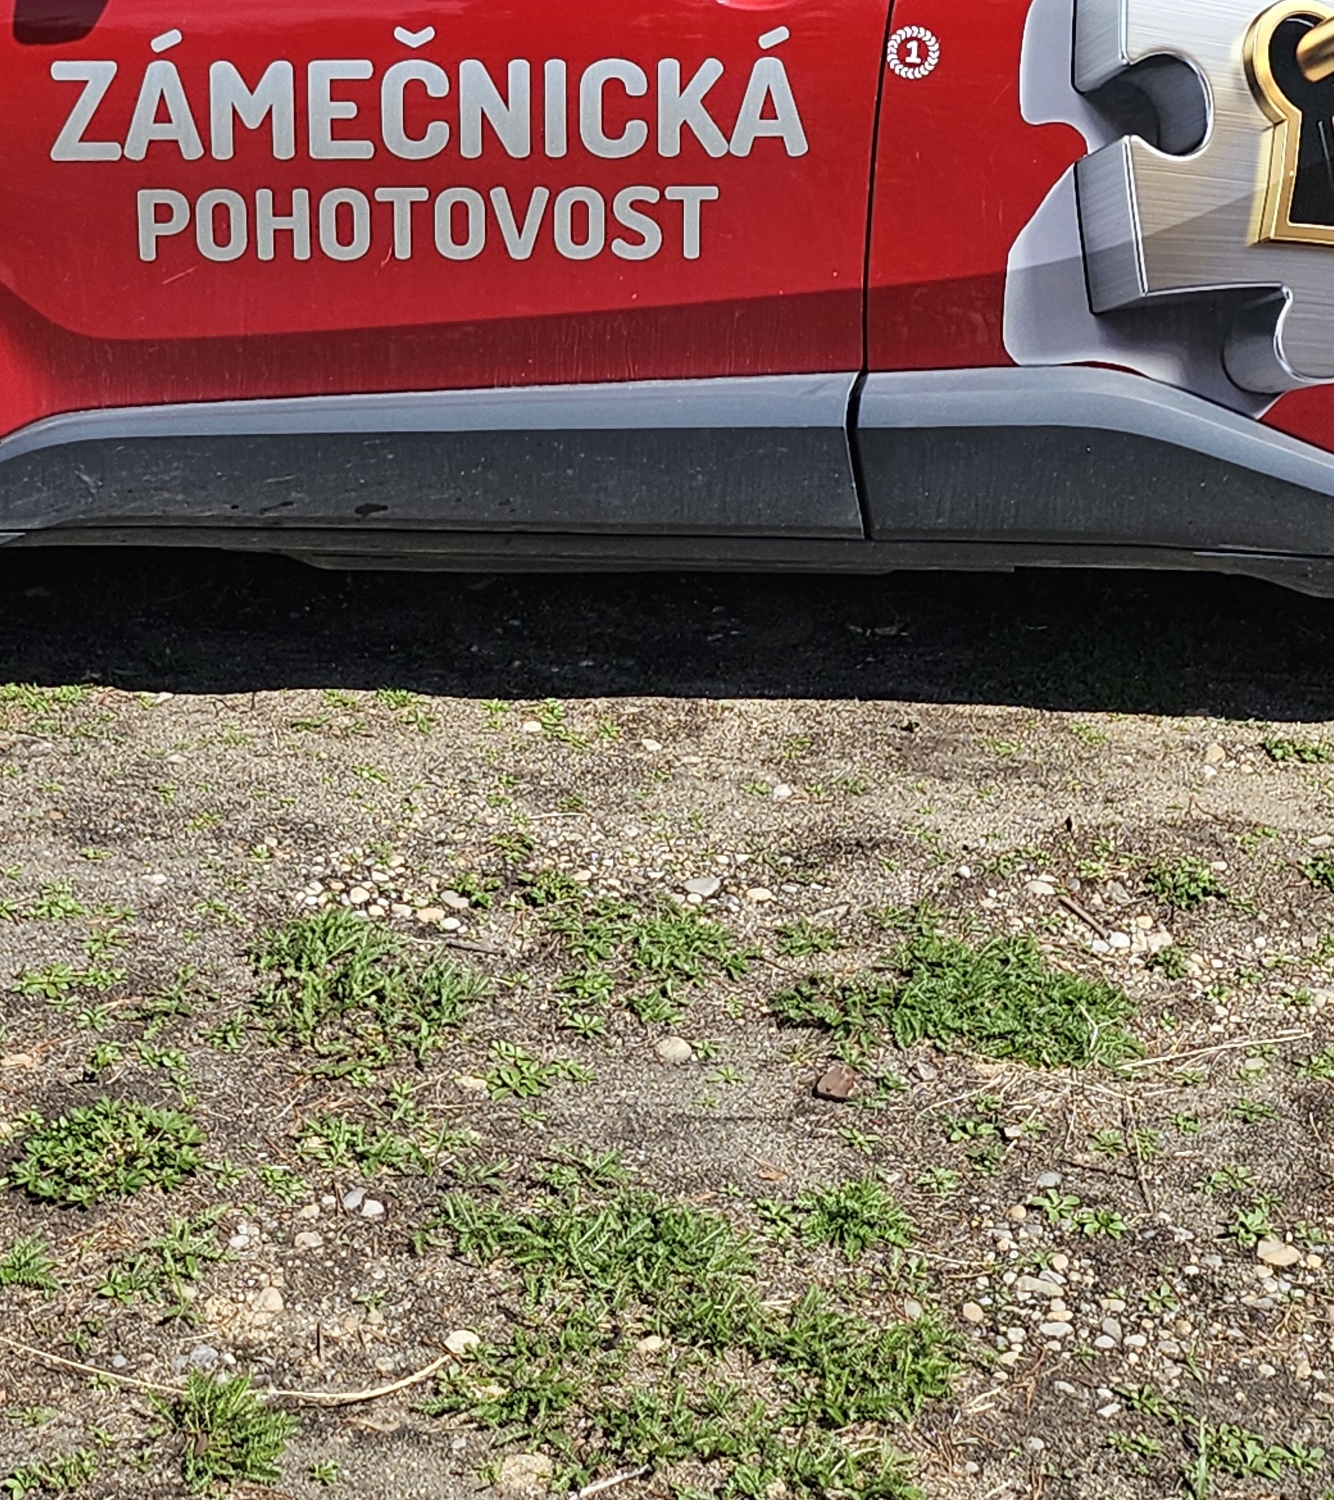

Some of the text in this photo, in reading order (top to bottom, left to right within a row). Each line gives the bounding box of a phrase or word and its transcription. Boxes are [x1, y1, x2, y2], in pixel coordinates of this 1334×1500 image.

[905, 40, 921, 64] 1
[50, 26, 809, 161] ZÁMEČNICKÁ
[137, 186, 719, 262] POHOTOVOST
